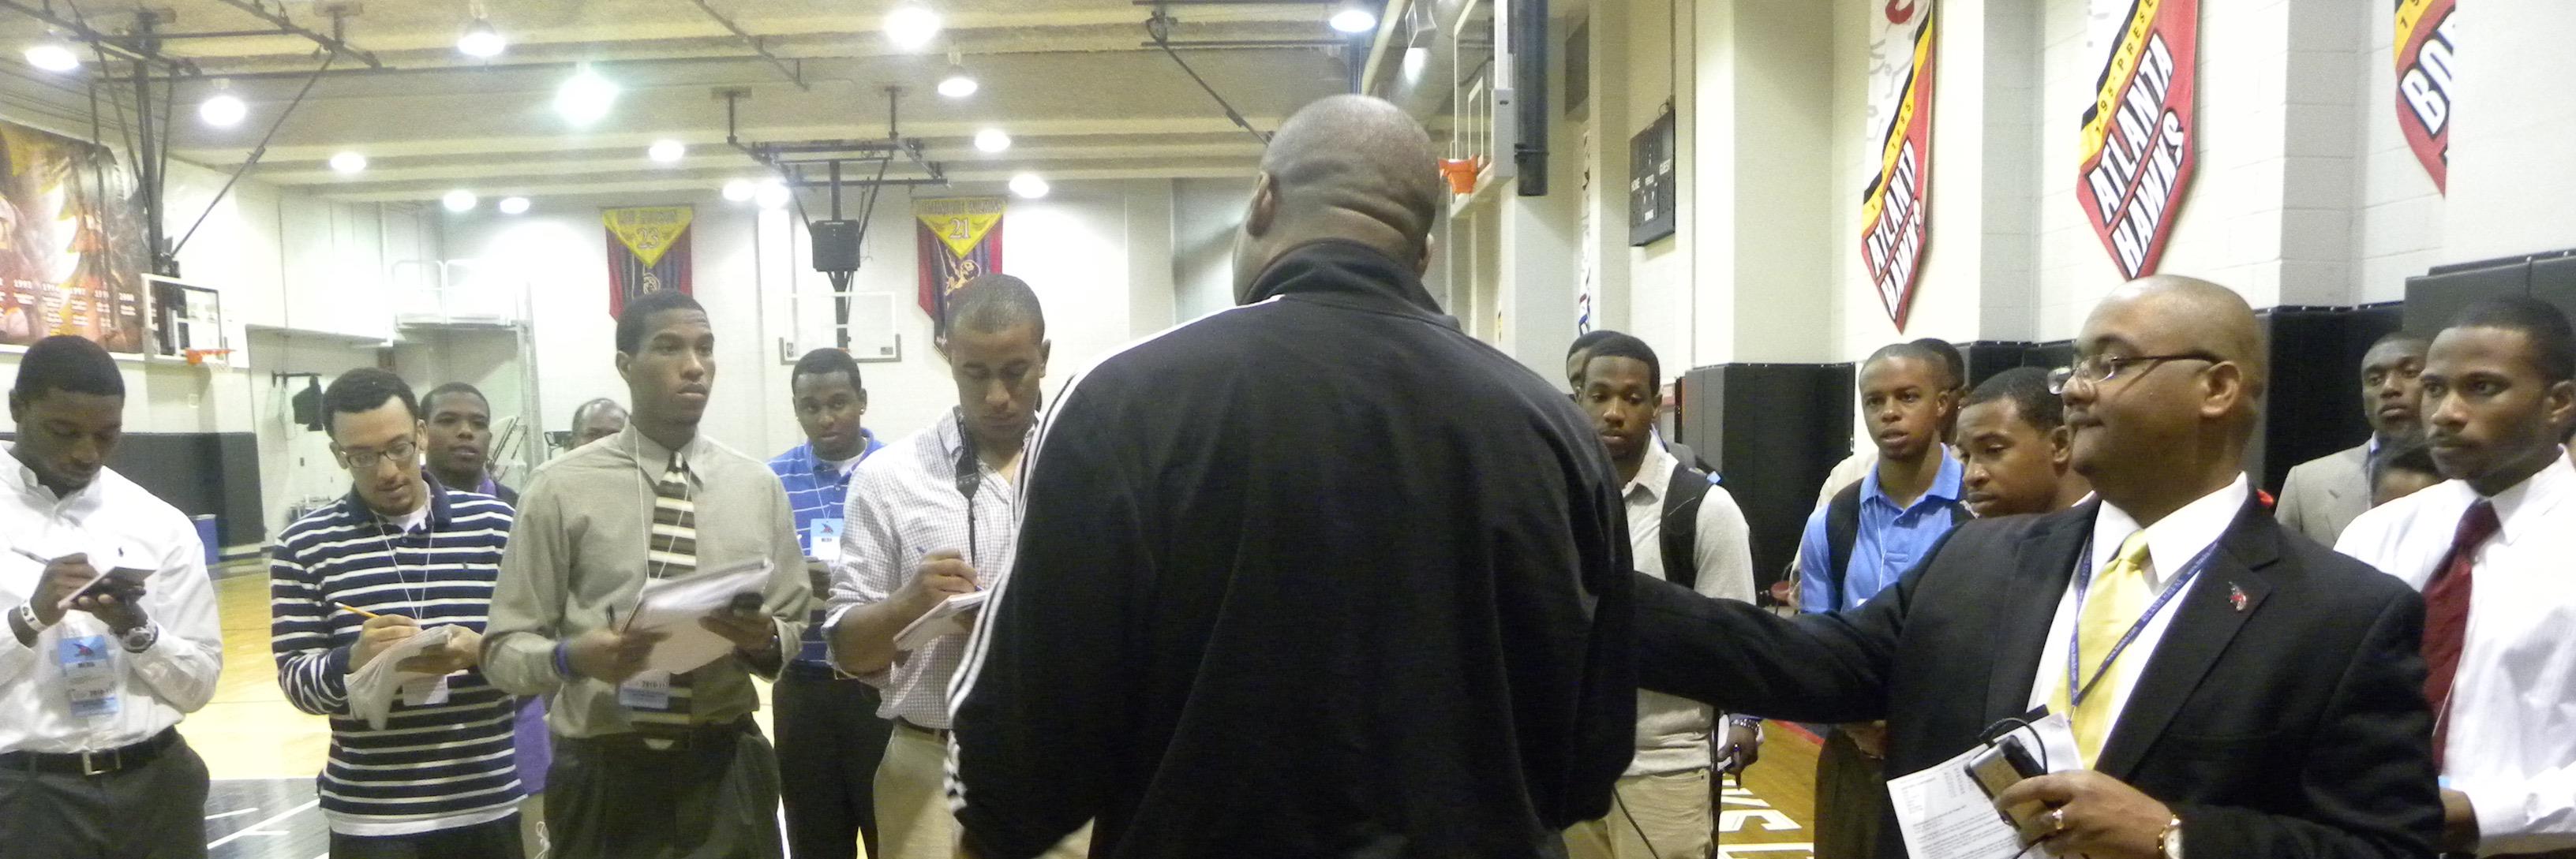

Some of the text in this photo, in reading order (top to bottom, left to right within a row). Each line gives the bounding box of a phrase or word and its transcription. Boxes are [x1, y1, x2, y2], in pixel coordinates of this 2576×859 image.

[2086, 30, 2173, 229] ATLANTA
[636, 227, 659, 249] 23
[949, 217, 970, 240] 21
[2110, 109, 2185, 280] HAWKS
